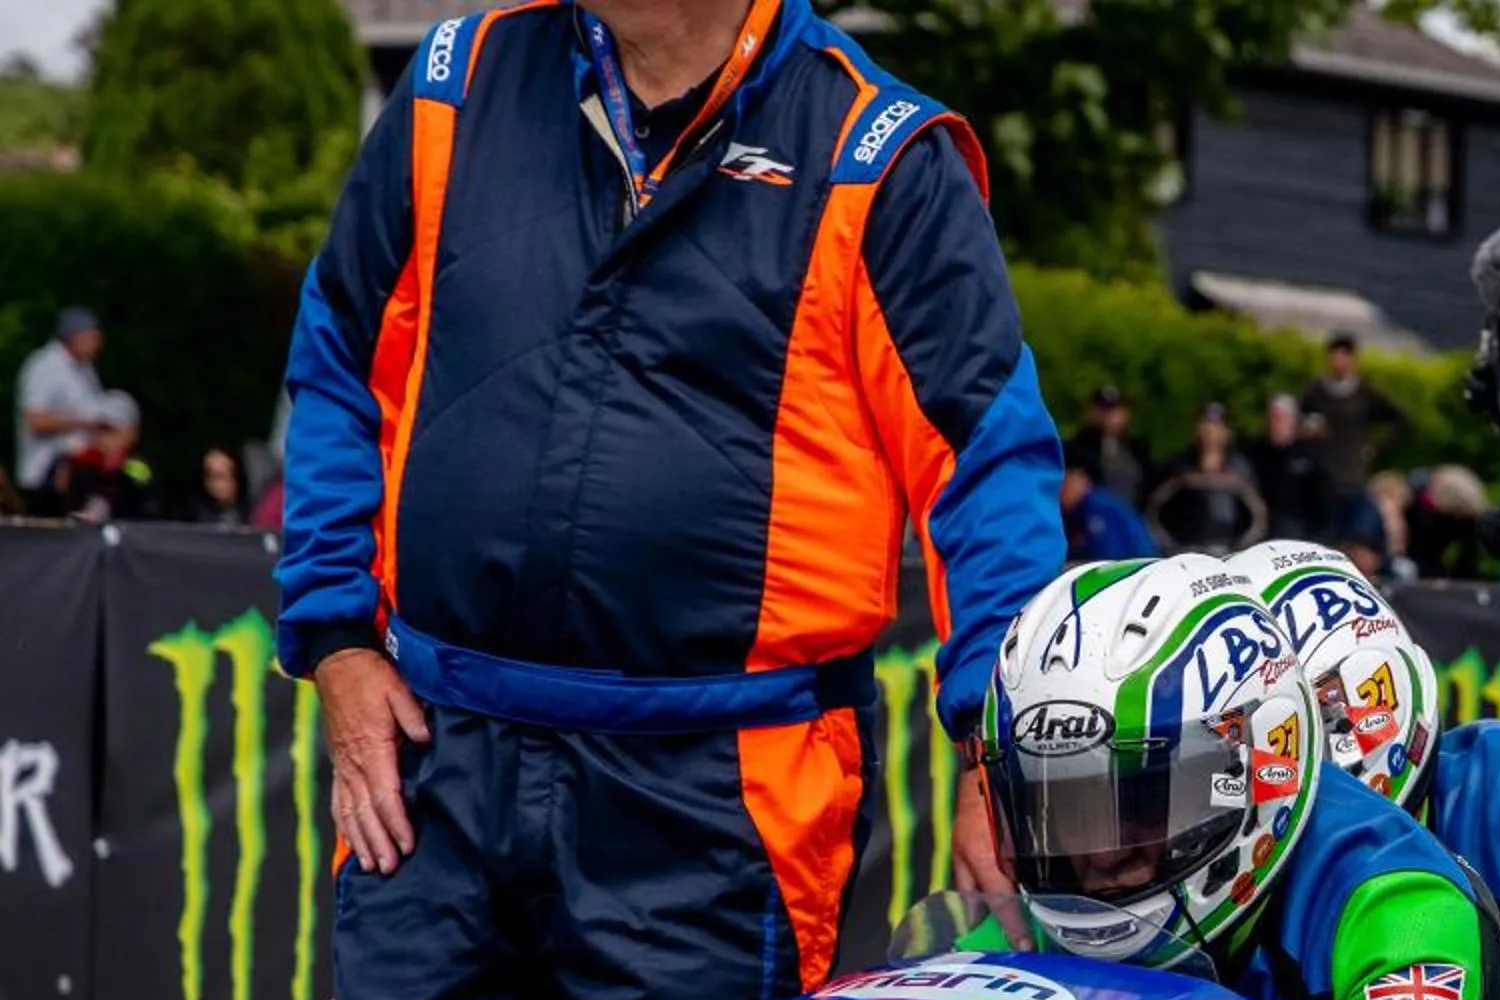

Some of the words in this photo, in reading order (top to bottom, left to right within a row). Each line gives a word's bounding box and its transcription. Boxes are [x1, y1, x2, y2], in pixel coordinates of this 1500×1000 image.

[427, 16, 463, 82] parco
[854, 101, 918, 164] sparco
[1284, 580, 1380, 655] LBS
[1197, 609, 1281, 713] LBS
[1012, 704, 1102, 742] Arai
[1261, 767, 1295, 781] Arai
